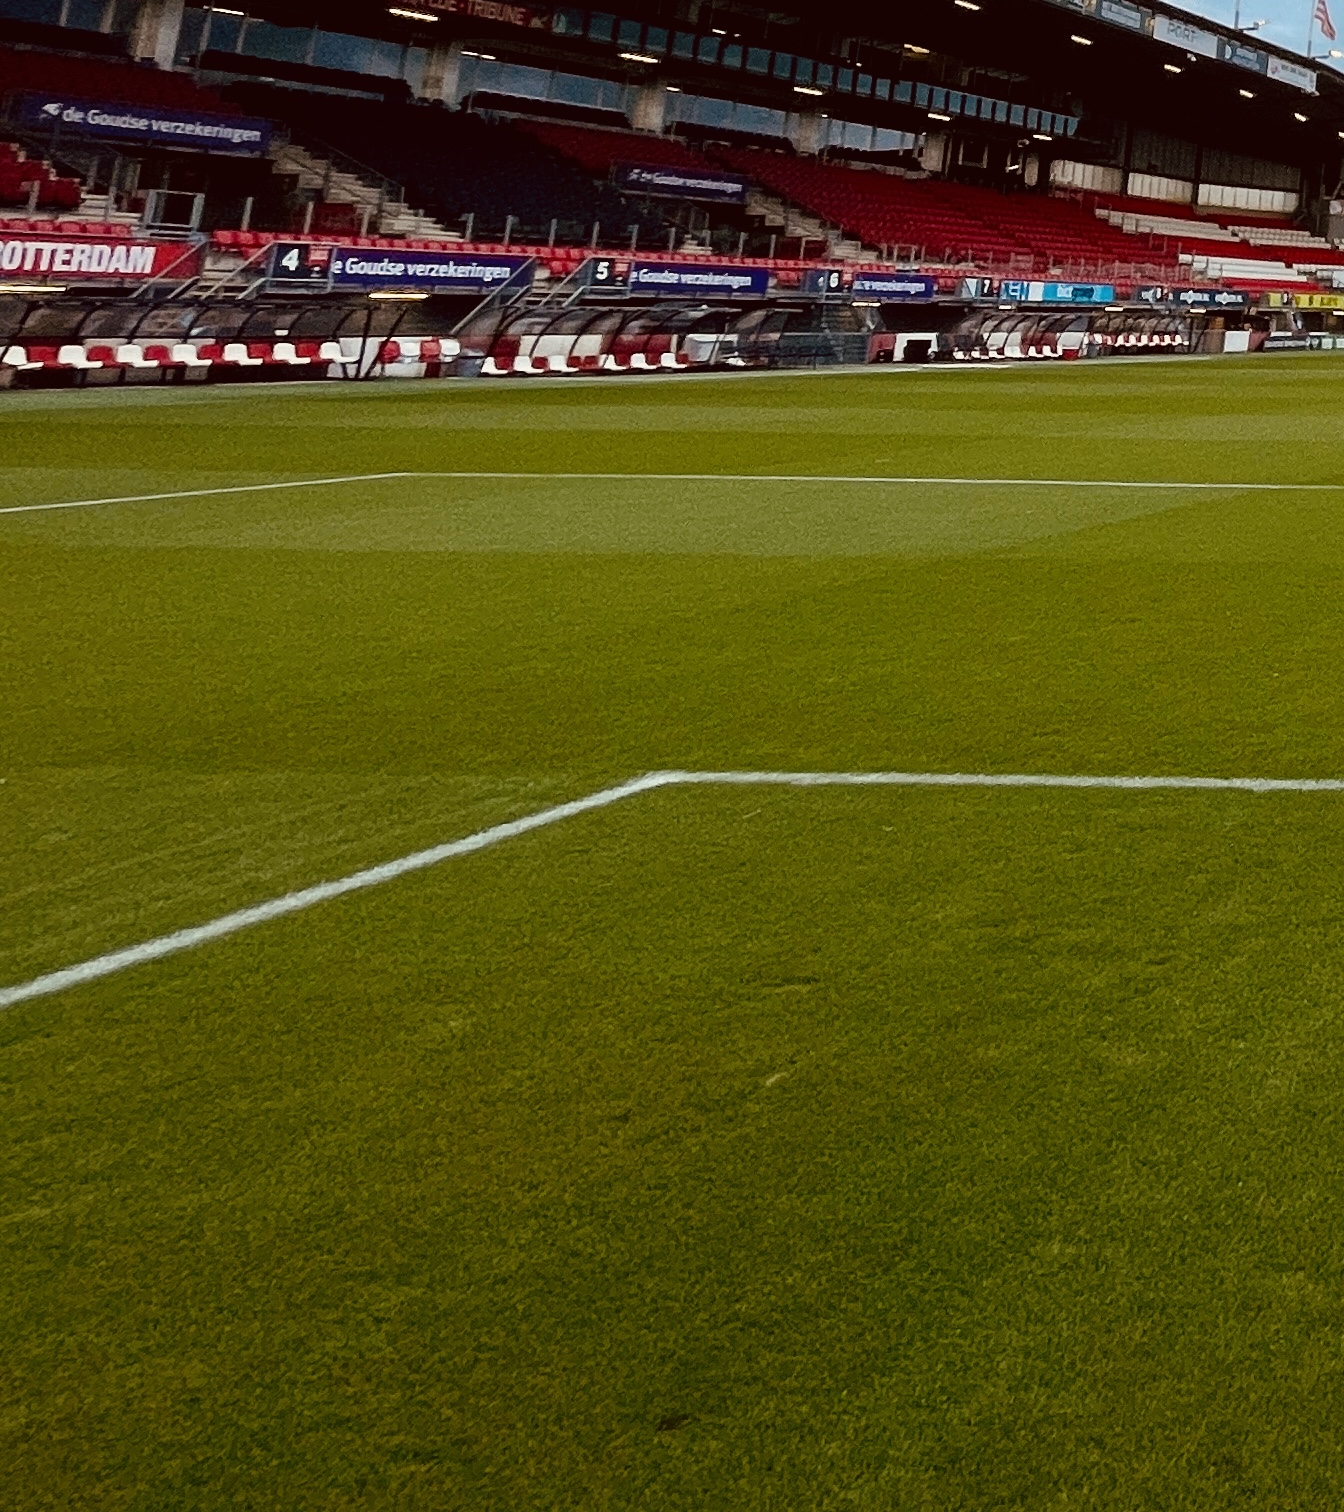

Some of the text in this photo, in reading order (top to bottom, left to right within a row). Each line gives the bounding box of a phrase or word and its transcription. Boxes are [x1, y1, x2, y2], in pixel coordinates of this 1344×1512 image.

[62, 107, 261, 143] de Goudse verzekeringen
[0, 240, 157, 274] OTTERDAM
[281, 248, 299, 272] 4
[345, 257, 404, 276] Goudse
[407, 262, 511, 282] verzekeringen
[596, 261, 610, 280] 5
[829, 272, 840, 288] 6
